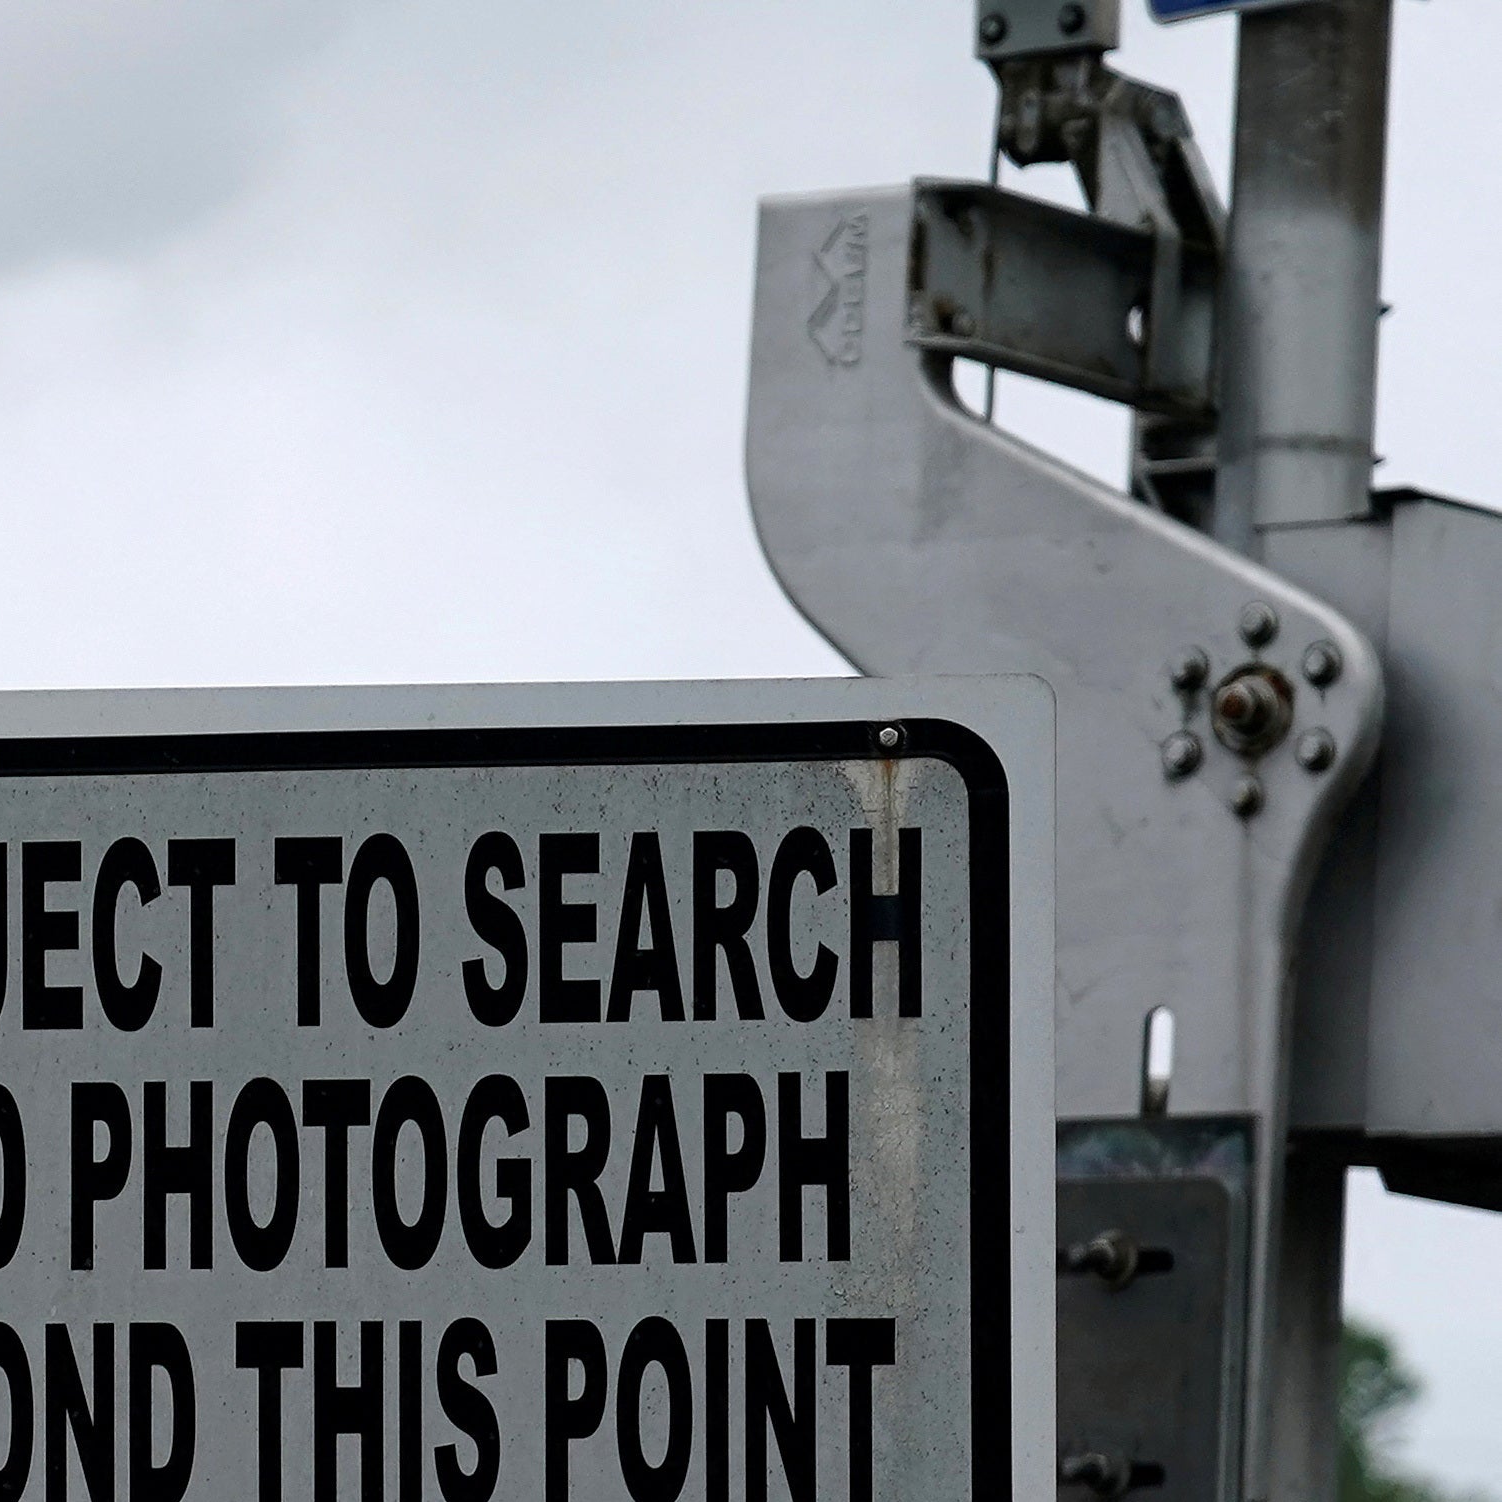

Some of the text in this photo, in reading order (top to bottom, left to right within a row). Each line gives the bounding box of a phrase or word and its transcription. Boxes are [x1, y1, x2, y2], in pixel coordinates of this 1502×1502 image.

[273, 832, 420, 1029] TO
[461, 824, 923, 1028] SEARCH
[70, 1070, 853, 1273] PHOTOGRAPH
